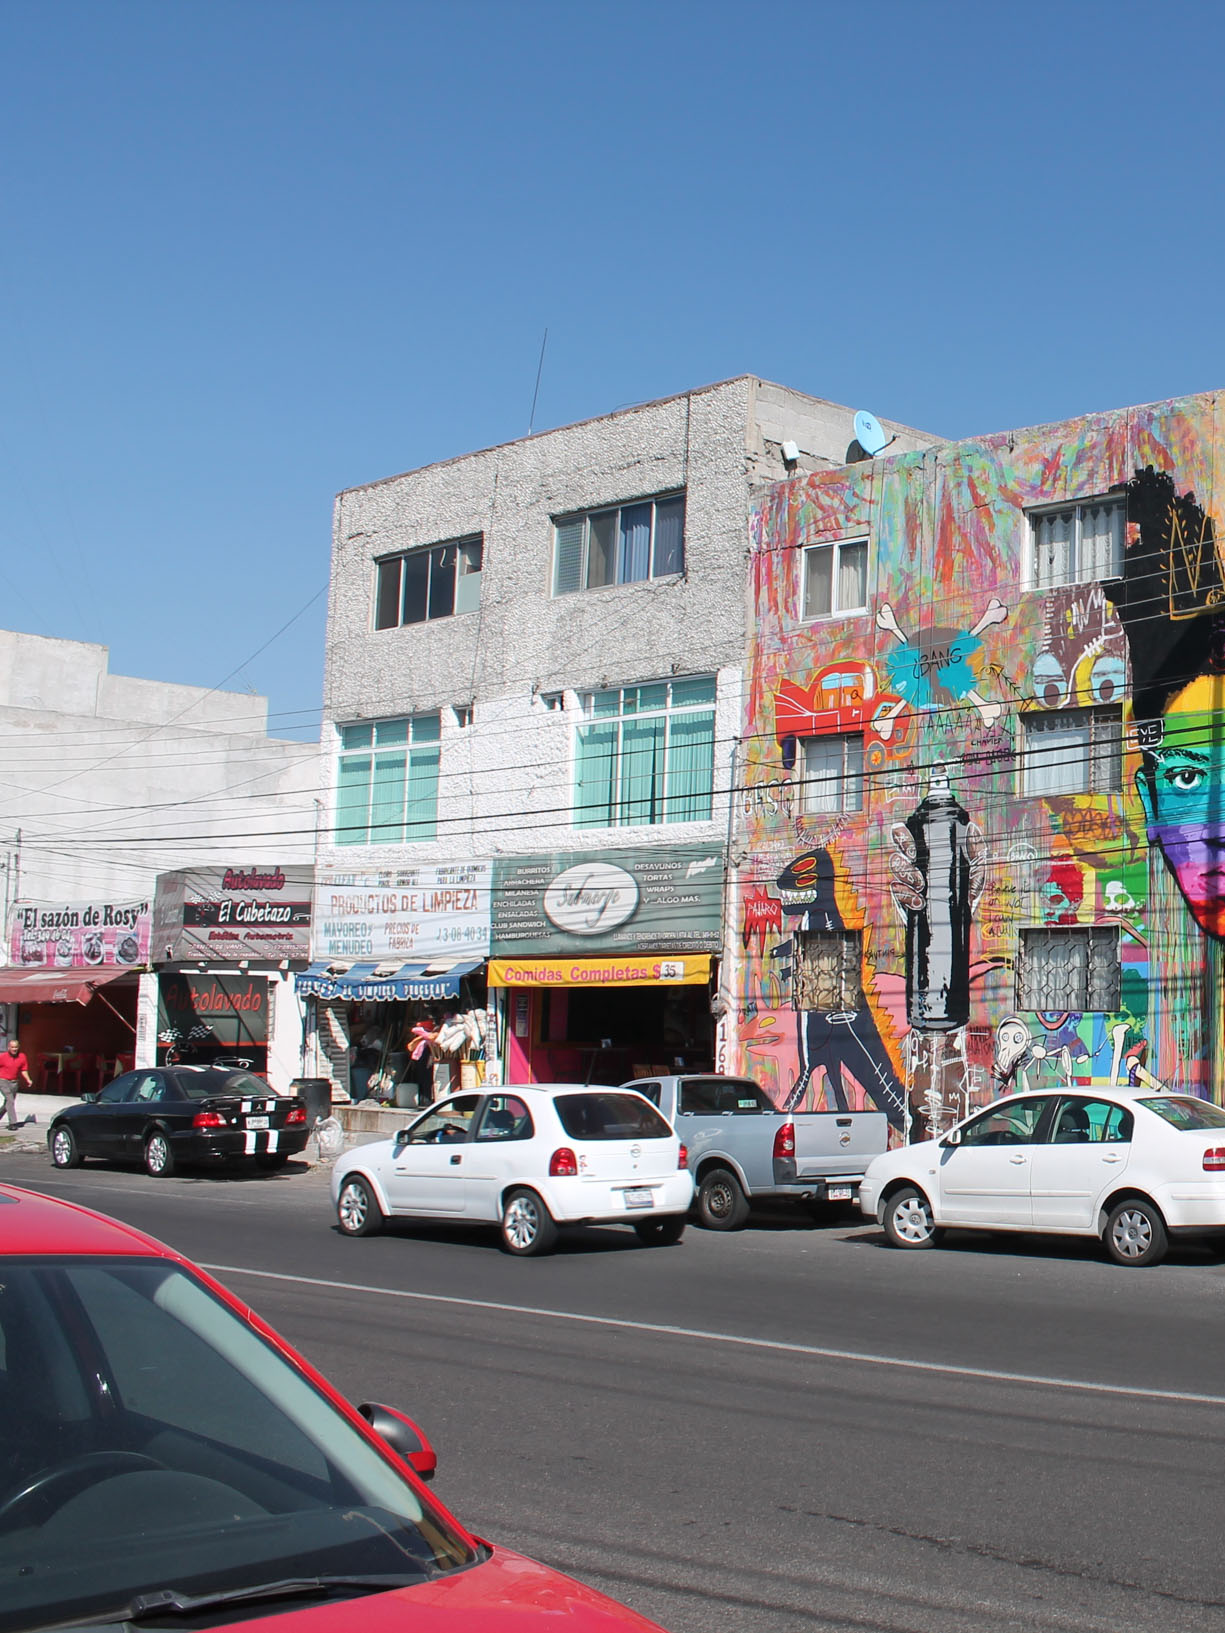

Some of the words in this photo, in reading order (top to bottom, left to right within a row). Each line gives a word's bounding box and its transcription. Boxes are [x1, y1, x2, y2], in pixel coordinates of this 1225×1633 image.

[634, 861, 682, 871] DESAYUNOS
[643, 873, 673, 881] TORTAS
[331, 894, 397, 914] PRODUCTOS
[401, 893, 418, 912] DE
[423, 889, 478, 912] LIMPIEZA
[41, 906, 79, 928] sazón
[83, 905, 100, 926] de
[218, 899, 232, 922] El
[236, 899, 291, 922] Cubetazo
[324, 922, 366, 937] MAYOREO
[508, 920, 547, 928] SANDWICH
[328, 939, 373, 955] MENUDEO
[504, 967, 562, 982] Comidas
[570, 965, 647, 984] Completas
